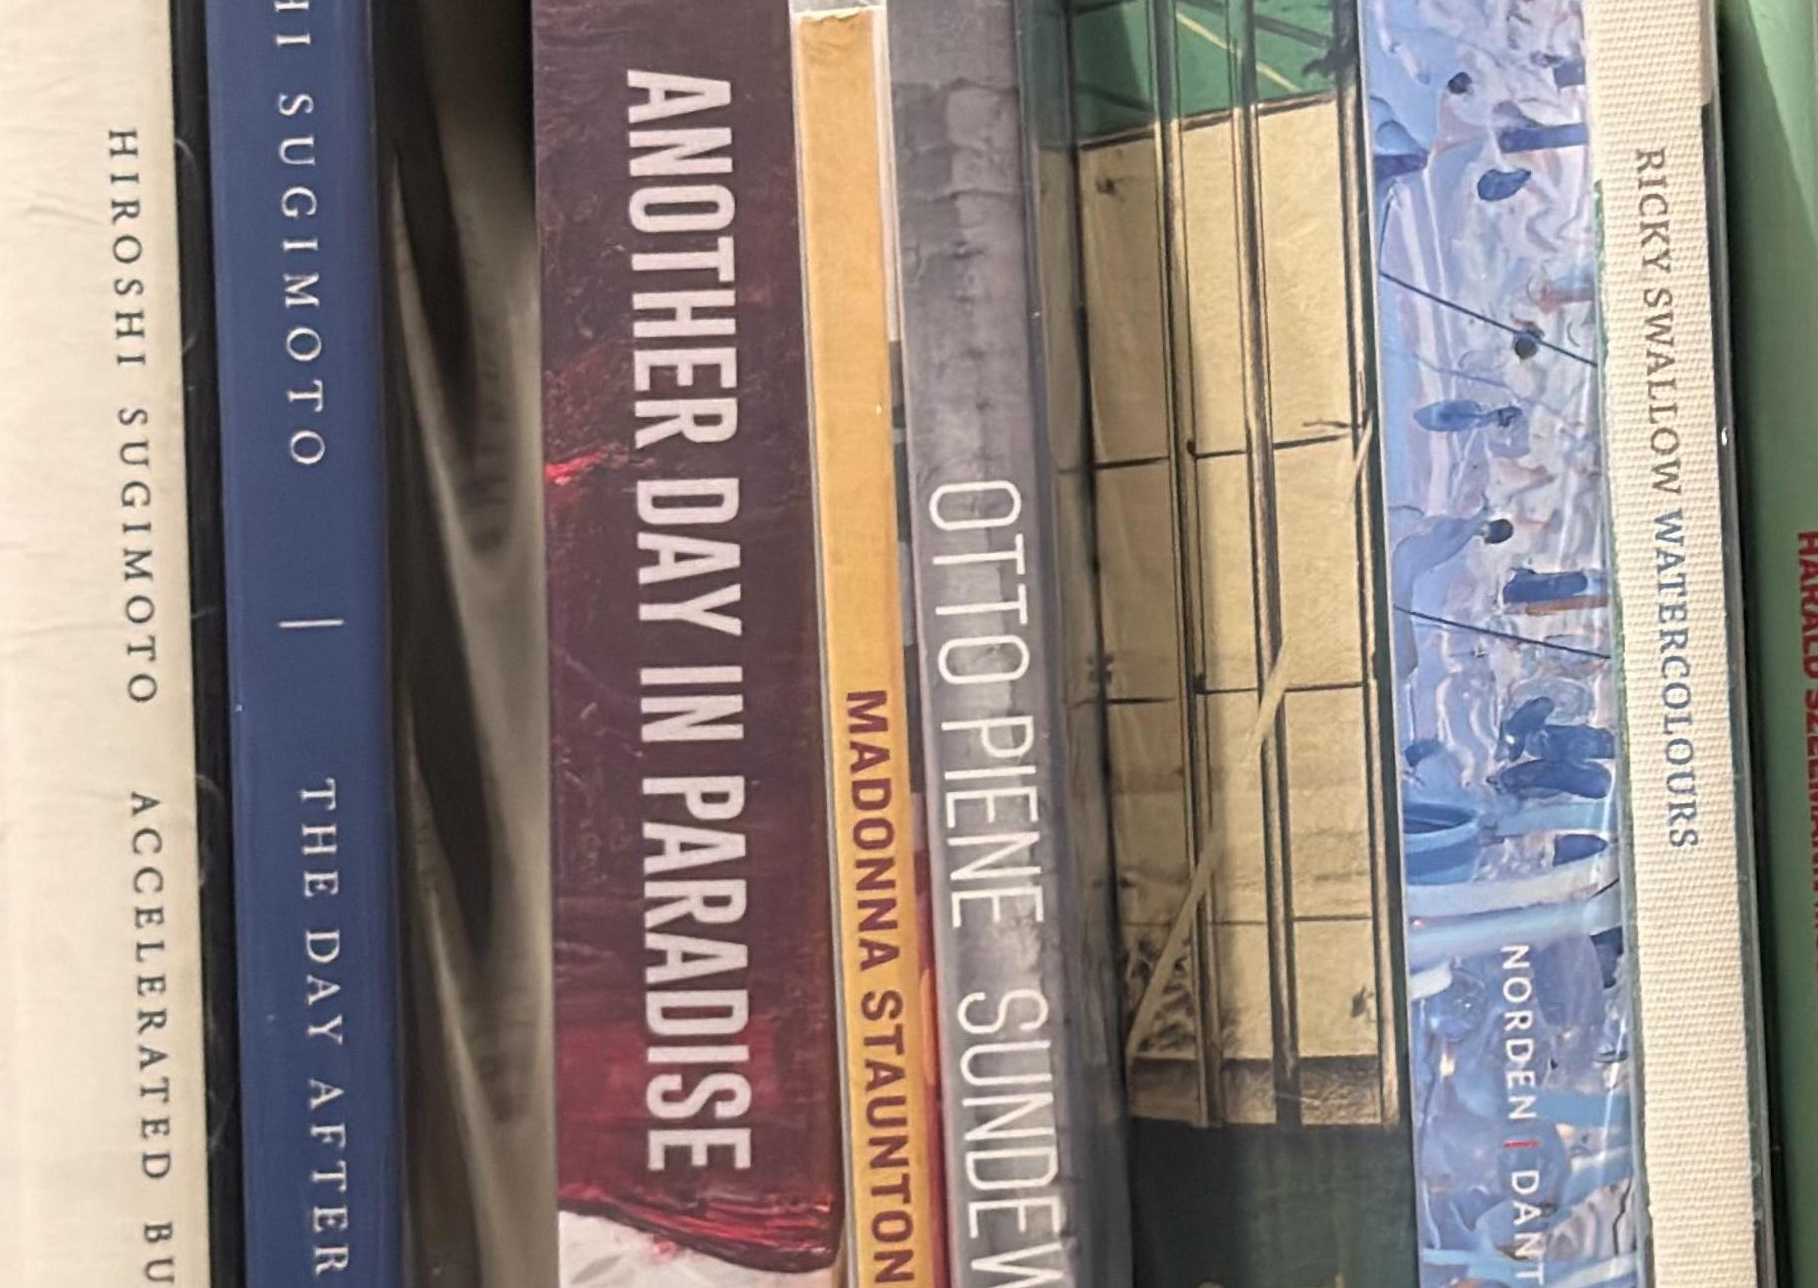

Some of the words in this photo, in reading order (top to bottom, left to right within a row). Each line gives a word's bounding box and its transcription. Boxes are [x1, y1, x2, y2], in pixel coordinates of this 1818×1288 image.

[107, 127, 150, 368] HIROSHI
[278, 92, 327, 467] SUGIMOTO
[626, 68, 741, 450] ANOTHER
[1634, 146, 1671, 277] RICKY
[1641, 284, 1683, 495] SWALLOW
[116, 406, 159, 705] SUGIMOTO
[634, 475, 744, 639] DAY
[927, 476, 1032, 690] OTTO
[638, 664, 745, 743] IN
[1654, 507, 1701, 851] WATERCOLOURS
[301, 779, 340, 899] THE
[844, 688, 902, 975] MADONNA
[940, 714, 1045, 928] PIENE
[130, 789, 180, 1183] ACCELERATED
[305, 927, 345, 1049] DAY
[640, 774, 754, 1173] PARADISE
[1499, 943, 1538, 1122] NORDEN
[309, 1078, 350, 1279] AFTER
[859, 989, 917, 1285] STAUNTON
